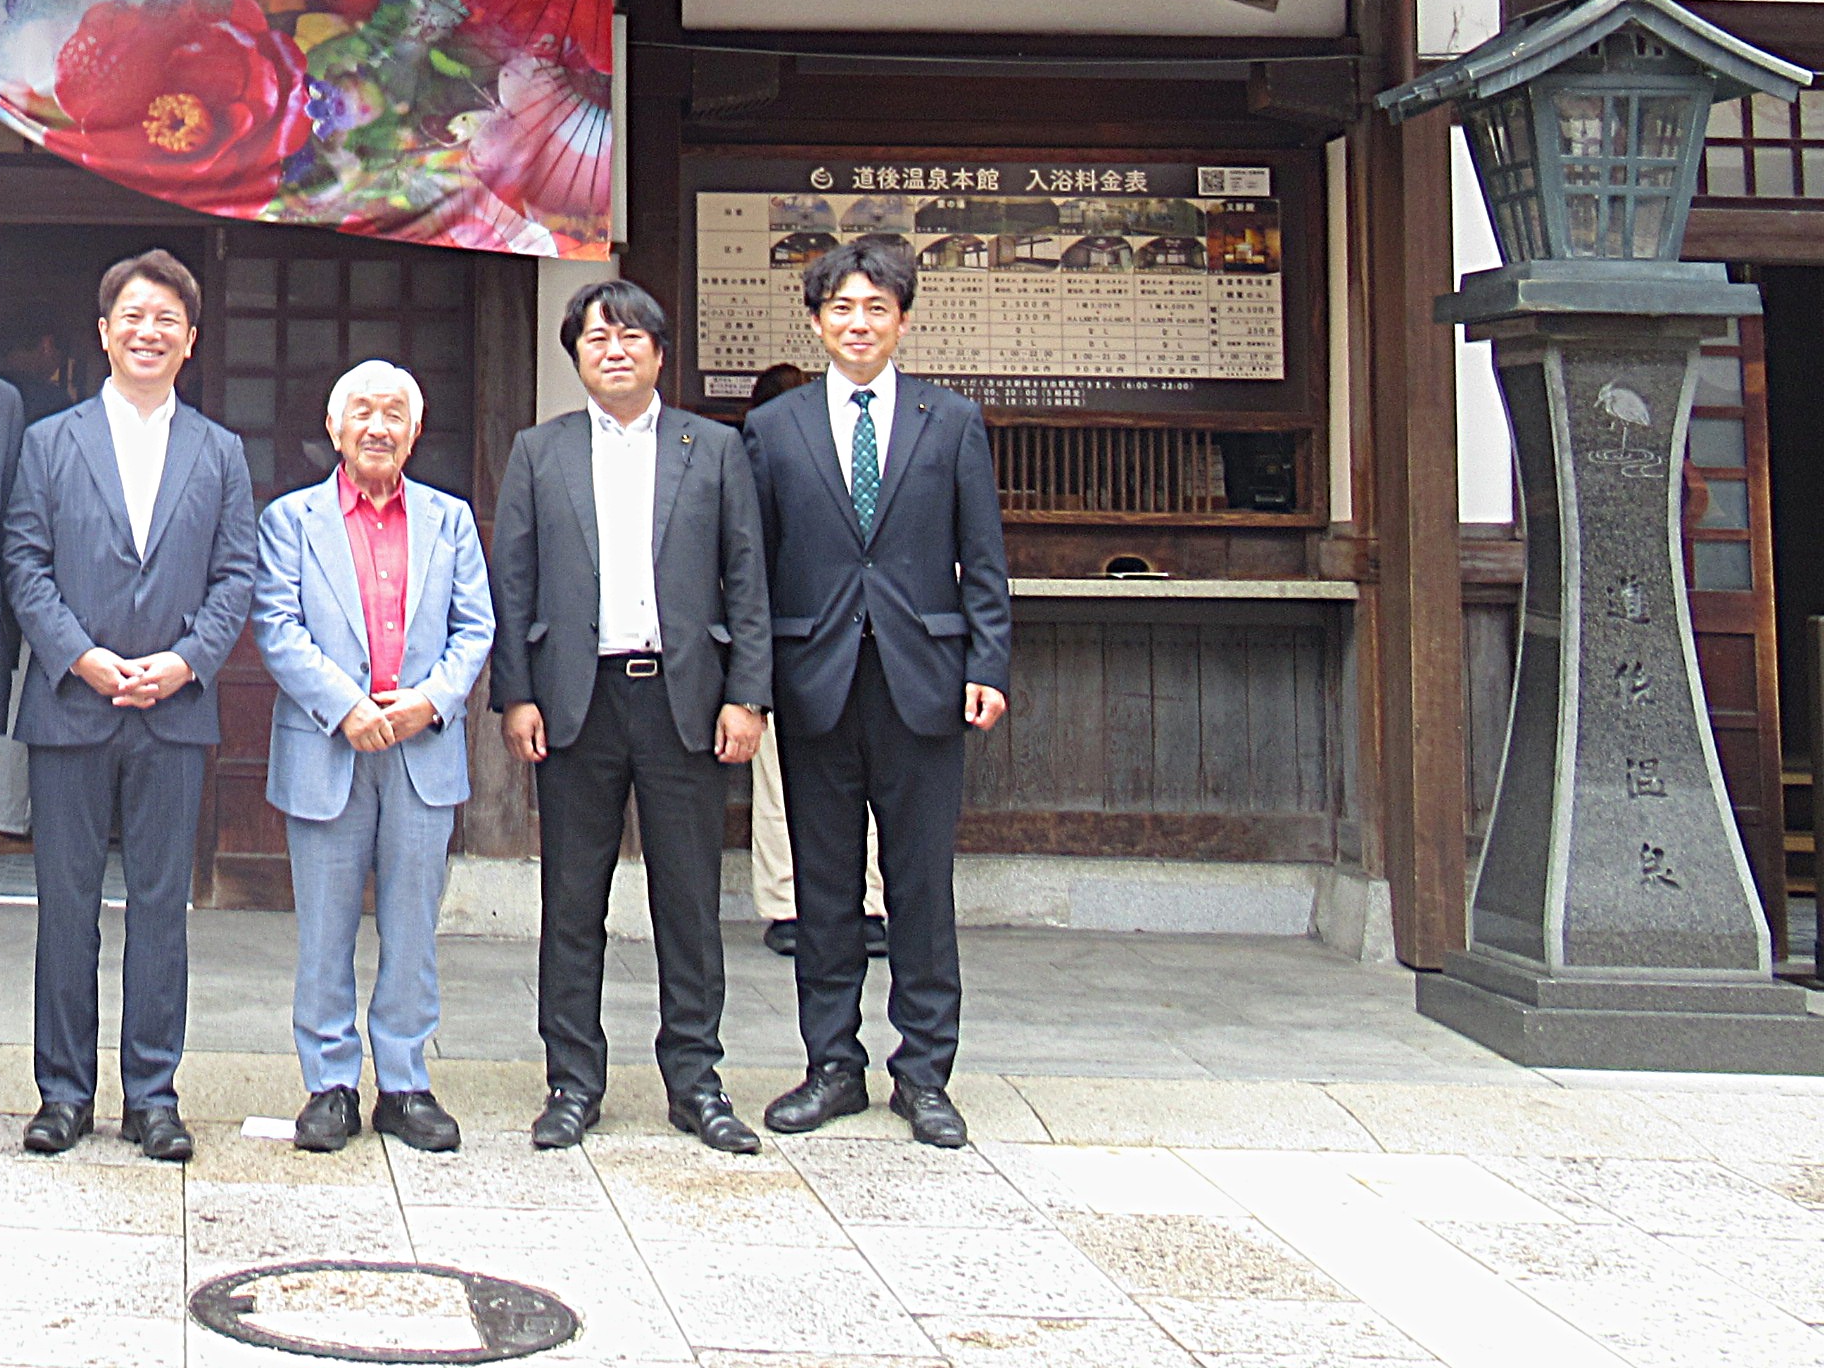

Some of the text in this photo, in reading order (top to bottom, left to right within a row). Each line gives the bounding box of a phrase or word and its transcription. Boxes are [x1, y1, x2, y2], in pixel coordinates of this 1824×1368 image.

[852, 166, 1149, 193] 道後温泉本館 入浴料金表
